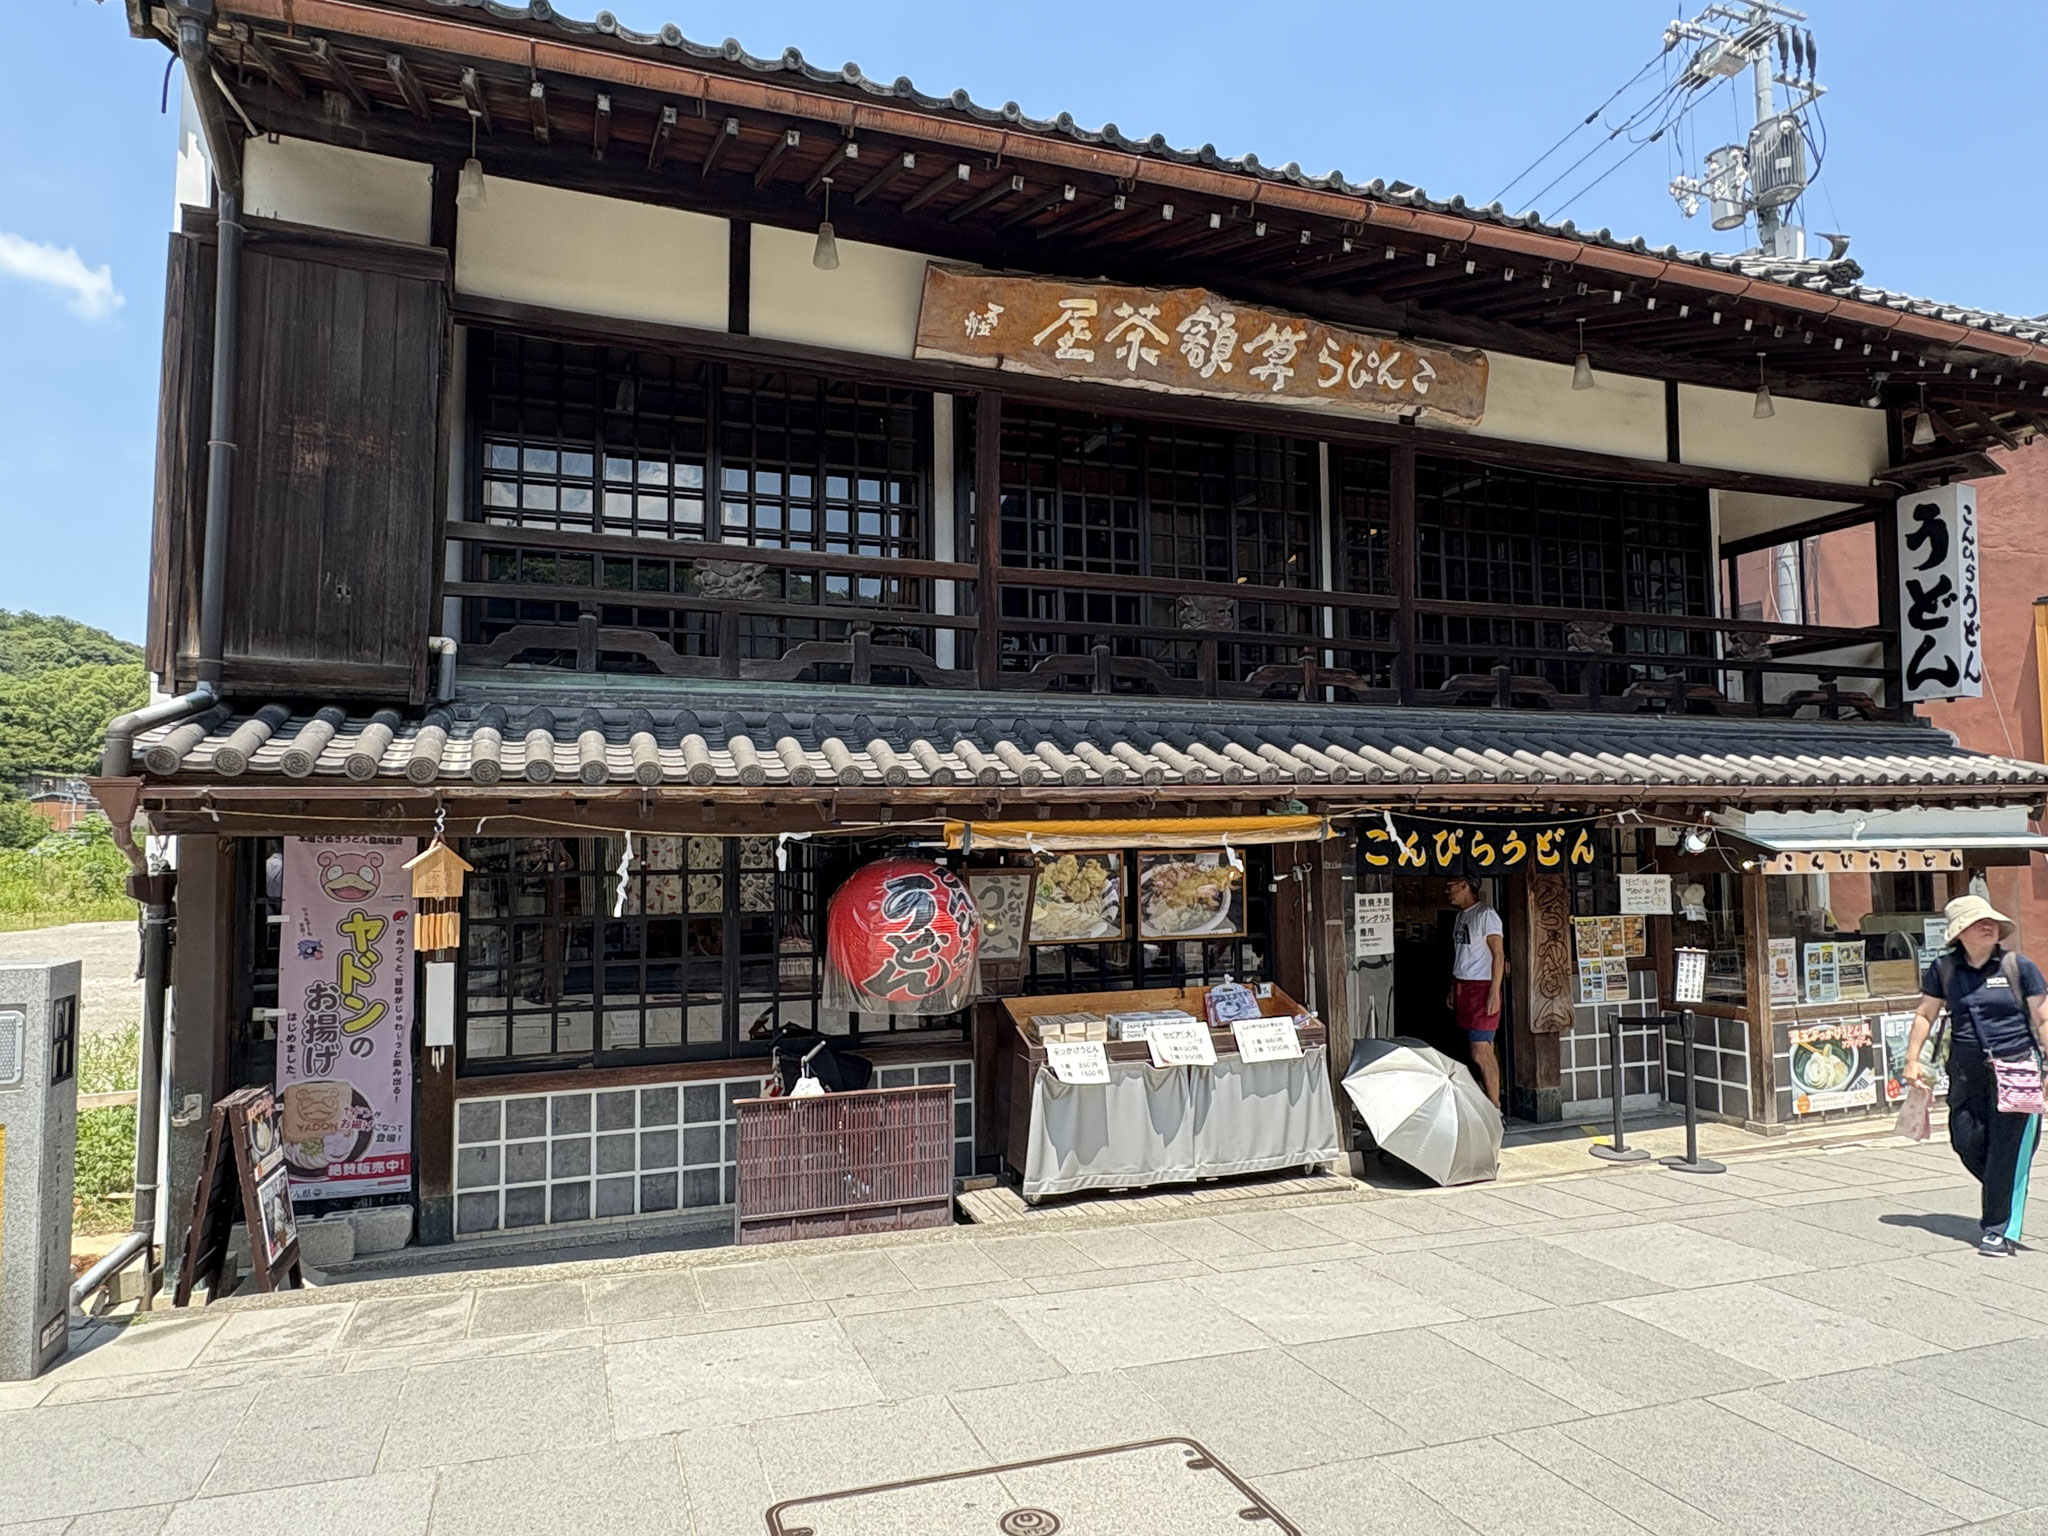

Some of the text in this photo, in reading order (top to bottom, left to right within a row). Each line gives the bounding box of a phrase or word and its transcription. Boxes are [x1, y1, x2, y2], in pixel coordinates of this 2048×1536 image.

[1905, 503, 1960, 691] うどん
[1962, 505, 1981, 683] こんぴらうどん
[1365, 828, 1595, 867] こんぴらうどん
[1785, 851, 1962, 871] こんぴらうどん
[978, 877, 1019, 953] うどん
[1359, 914, 1391, 923] サングラス
[861, 873, 951, 998] うどん
[303, 980, 343, 1077] お揚げ
[286, 1012, 298, 1079] はじめました。
[1053, 1045, 1100, 1055] ぶっかけうどん
[297, 1122, 338, 1133] YADON
[340, 1119, 404, 1132] お揚げになって
[327, 1159, 405, 1177] 絶賛販売中！
[290, 1188, 312, 1199] ん県
